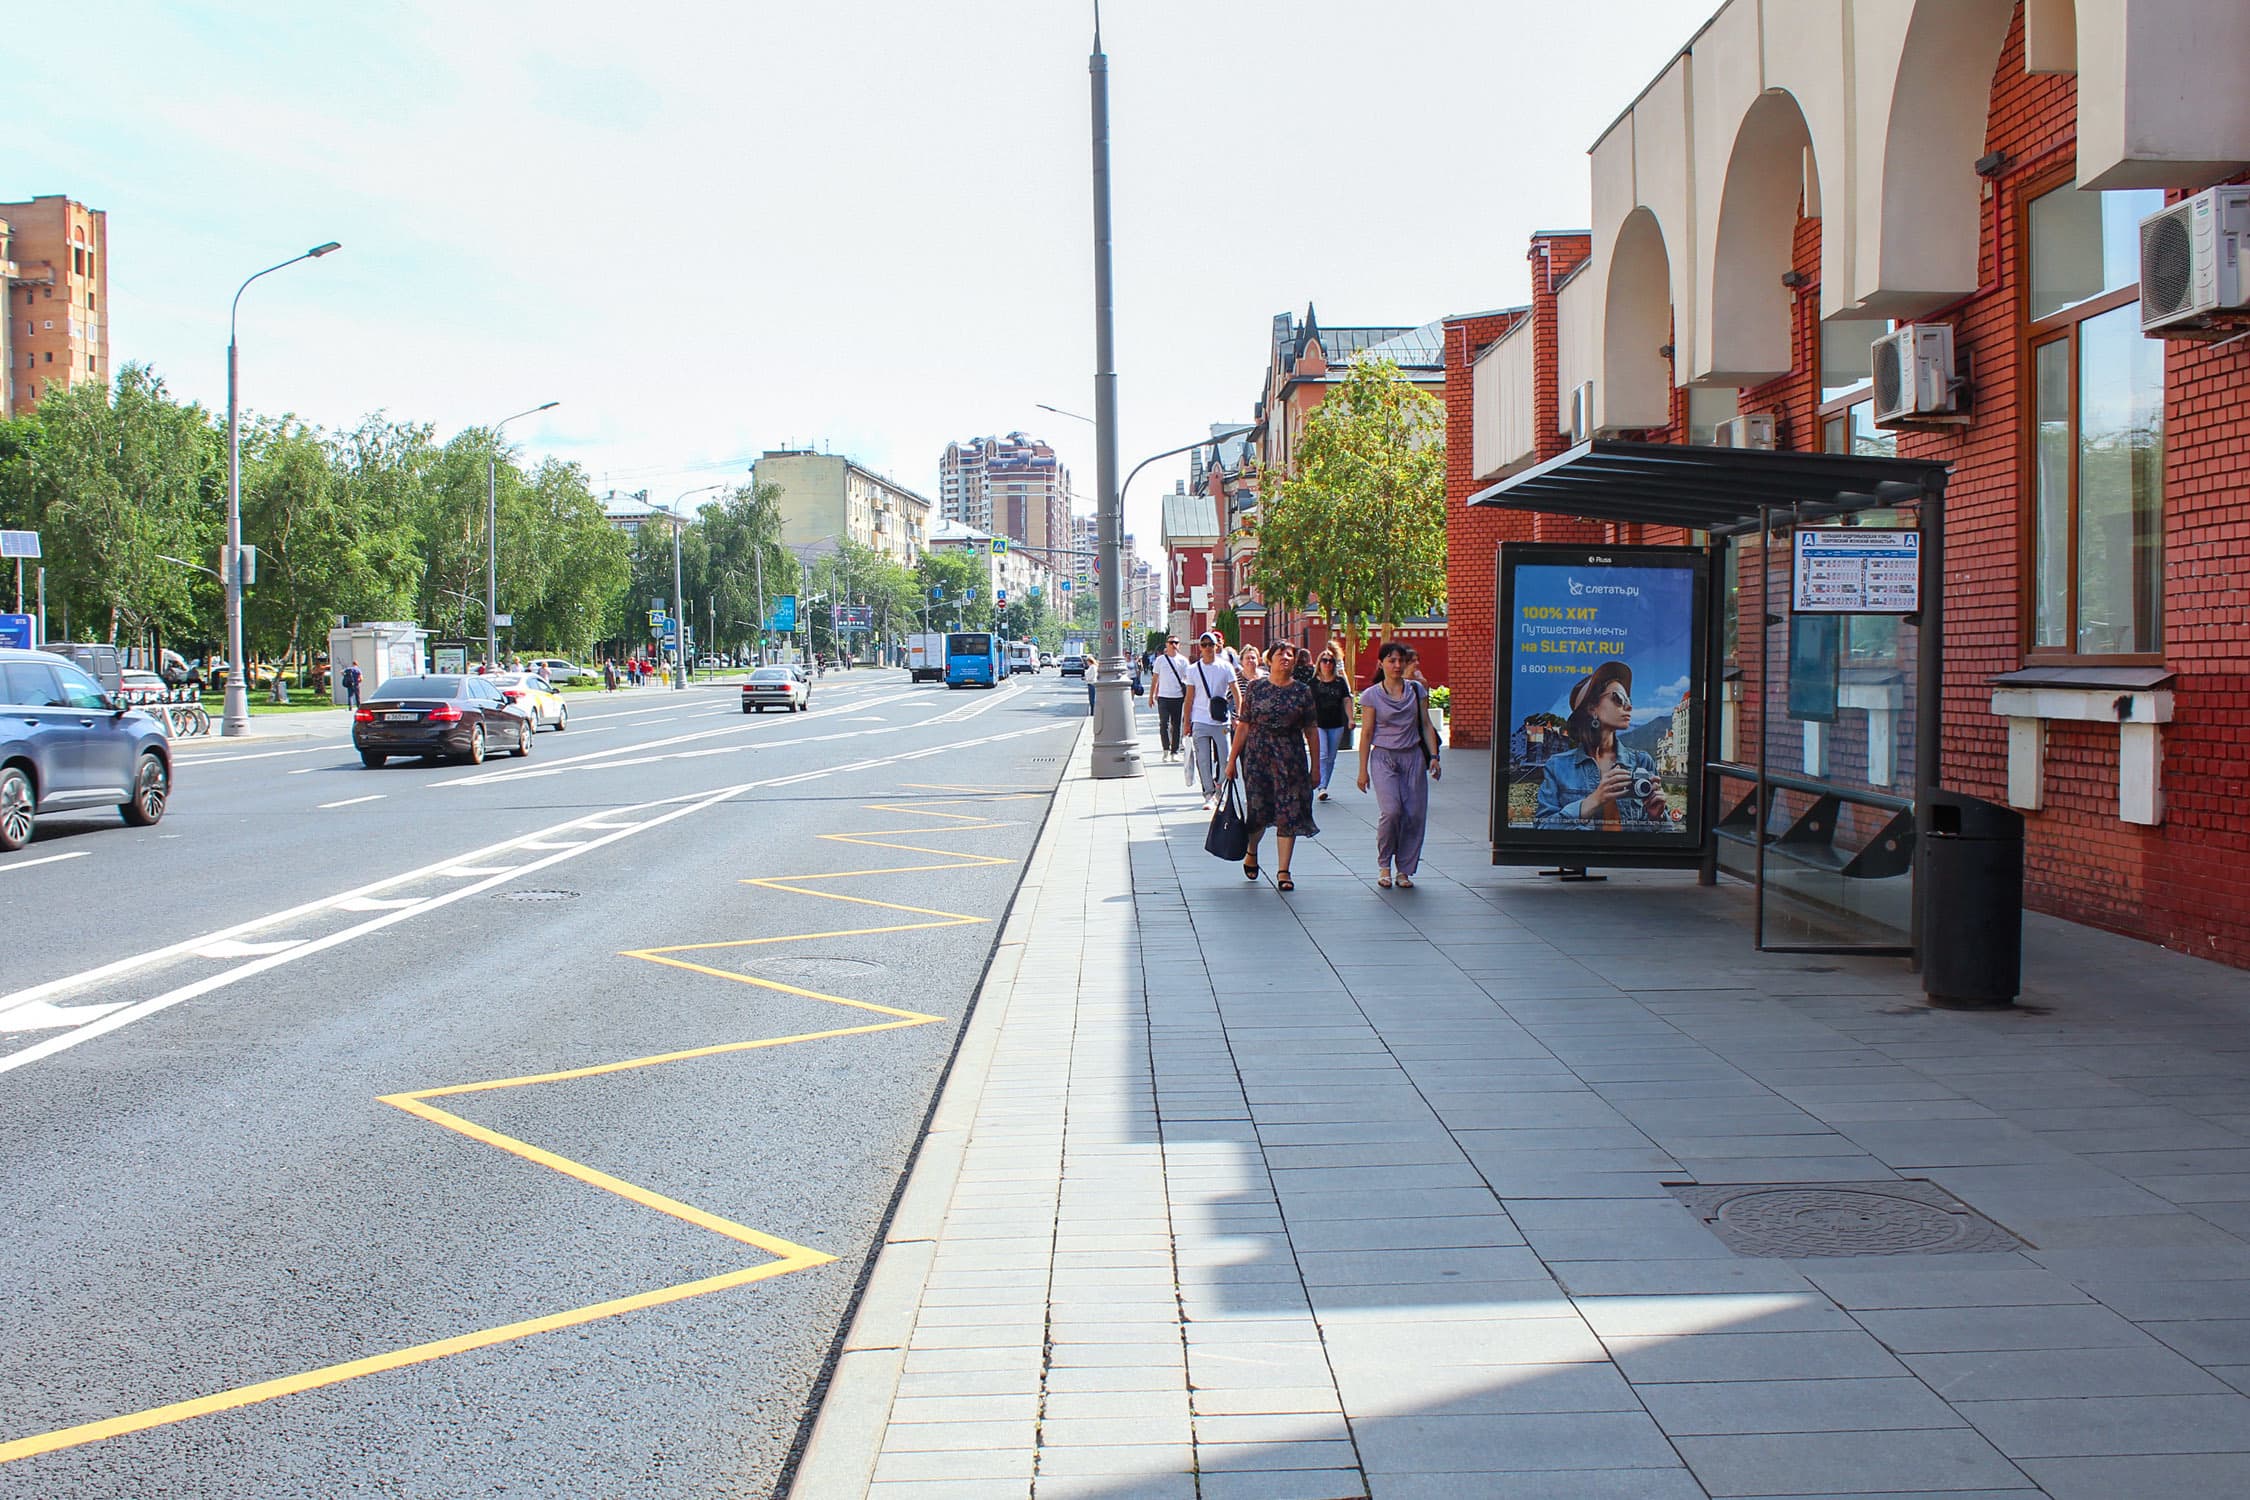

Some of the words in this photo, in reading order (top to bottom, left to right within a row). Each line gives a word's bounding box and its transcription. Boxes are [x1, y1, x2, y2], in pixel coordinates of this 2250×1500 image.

[1585, 585, 1639, 597] слетать.ру
[1522, 606, 1563, 620] 100%
[1566, 607, 1598, 621] ХИТ
[1521, 623, 1592, 636] Путешествие
[1594, 626, 1628, 636] мечты
[1521, 642, 1538, 653] на
[1541, 640, 1625, 655] SLETAT.RU!
[1521, 664, 1527, 673] 8
[1528, 664, 1547, 673] 800
